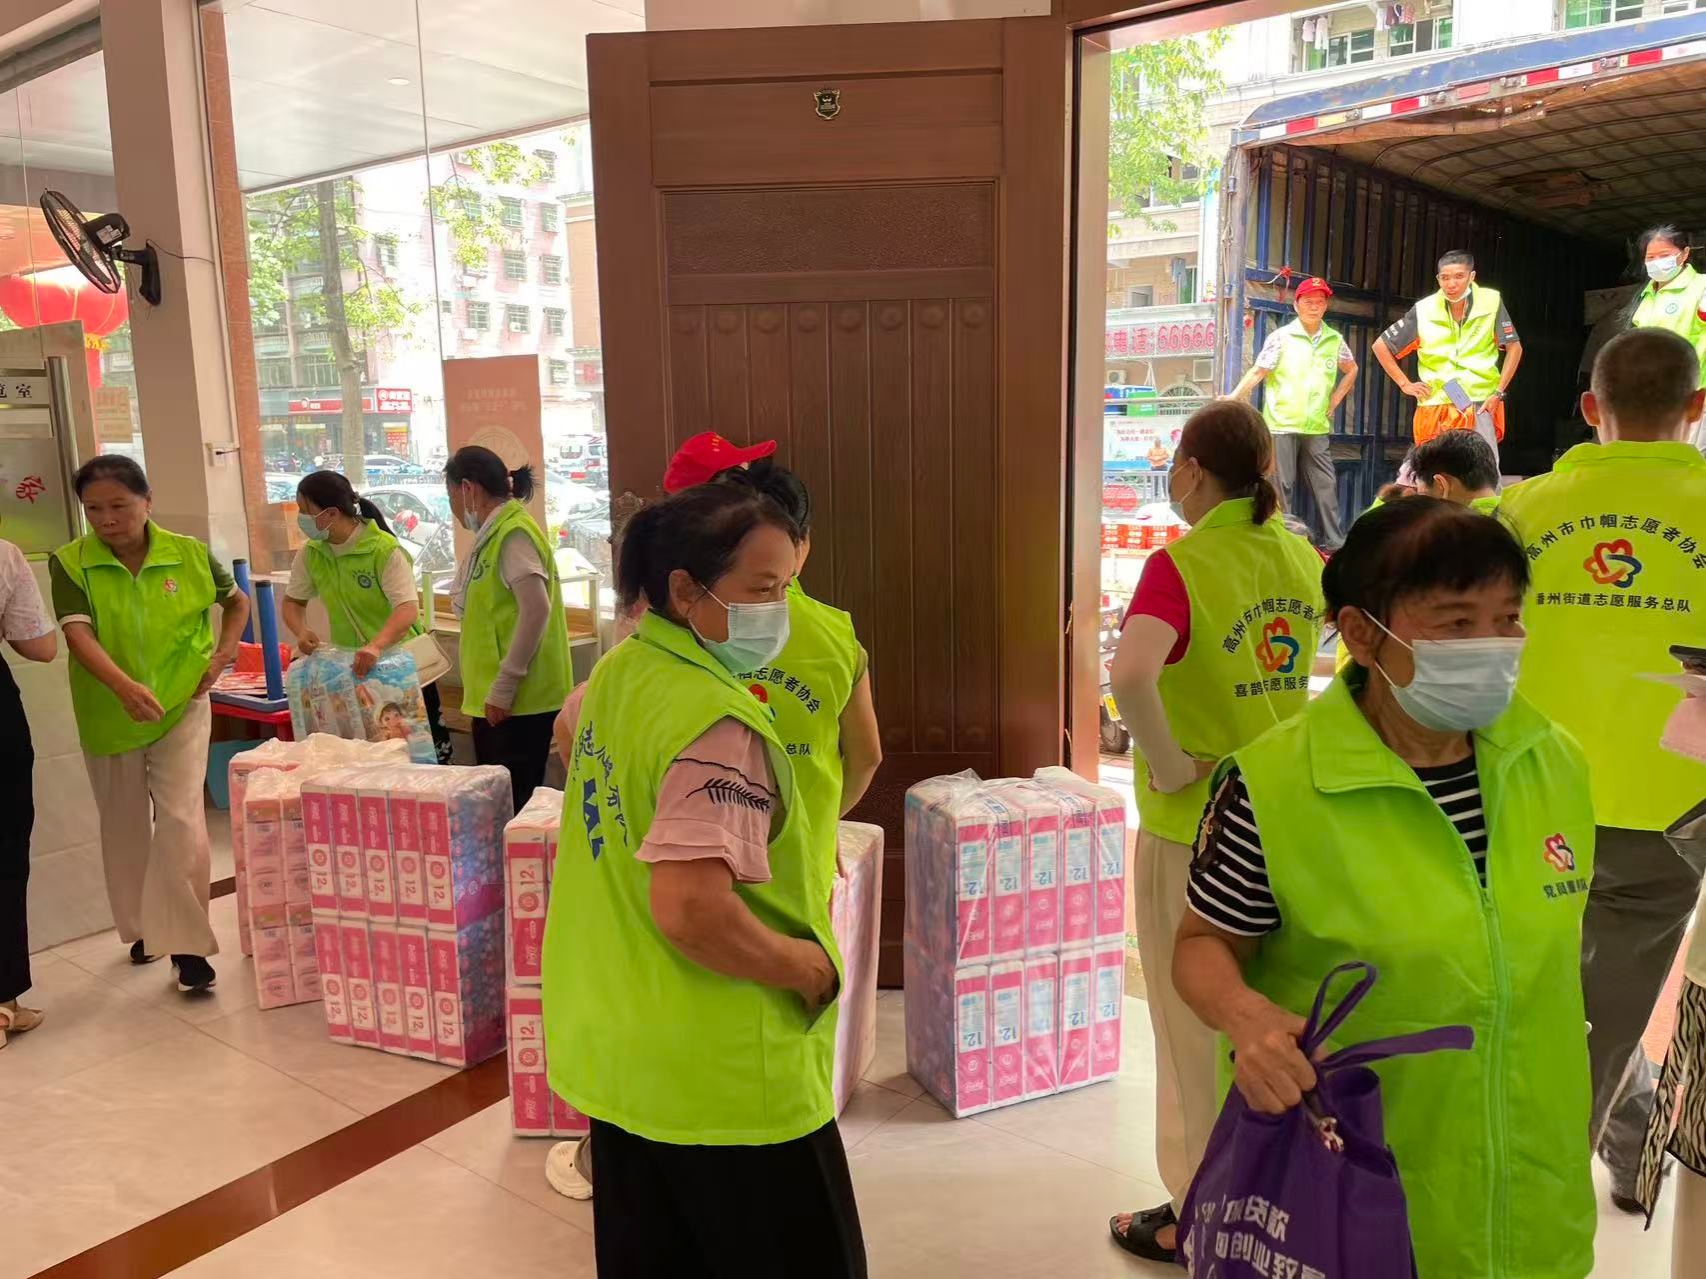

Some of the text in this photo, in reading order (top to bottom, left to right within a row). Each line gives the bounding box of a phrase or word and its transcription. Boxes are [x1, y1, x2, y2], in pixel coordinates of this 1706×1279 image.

[1223, 597, 1320, 653] 高州市巾帼志愿者
[786, 742, 811, 755] 总队
[520, 870, 535, 886] 12
[433, 885, 445, 899] 12
[442, 1021, 454, 1036] 12
[520, 1026, 535, 1041] 12
